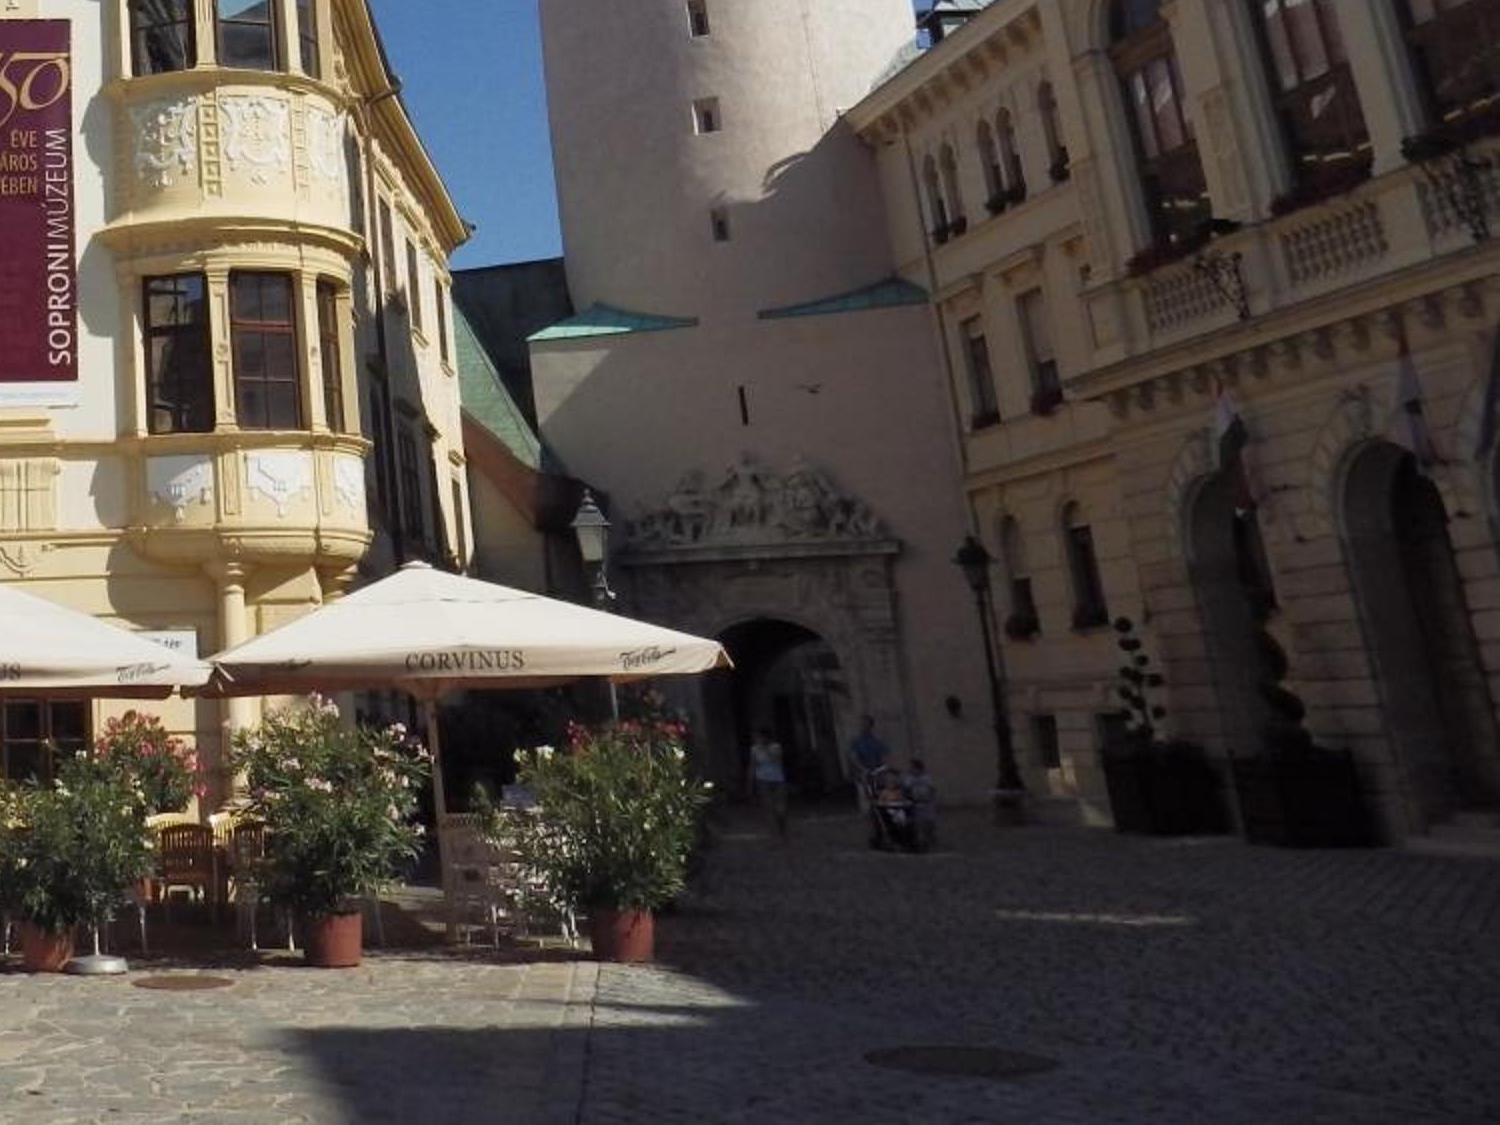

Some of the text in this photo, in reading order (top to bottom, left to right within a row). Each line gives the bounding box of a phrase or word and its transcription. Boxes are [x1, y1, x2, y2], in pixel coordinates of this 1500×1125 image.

[41, 128, 71, 365] SOPRONI MÚZEUM
[404, 650, 525, 670] CORVINUS
